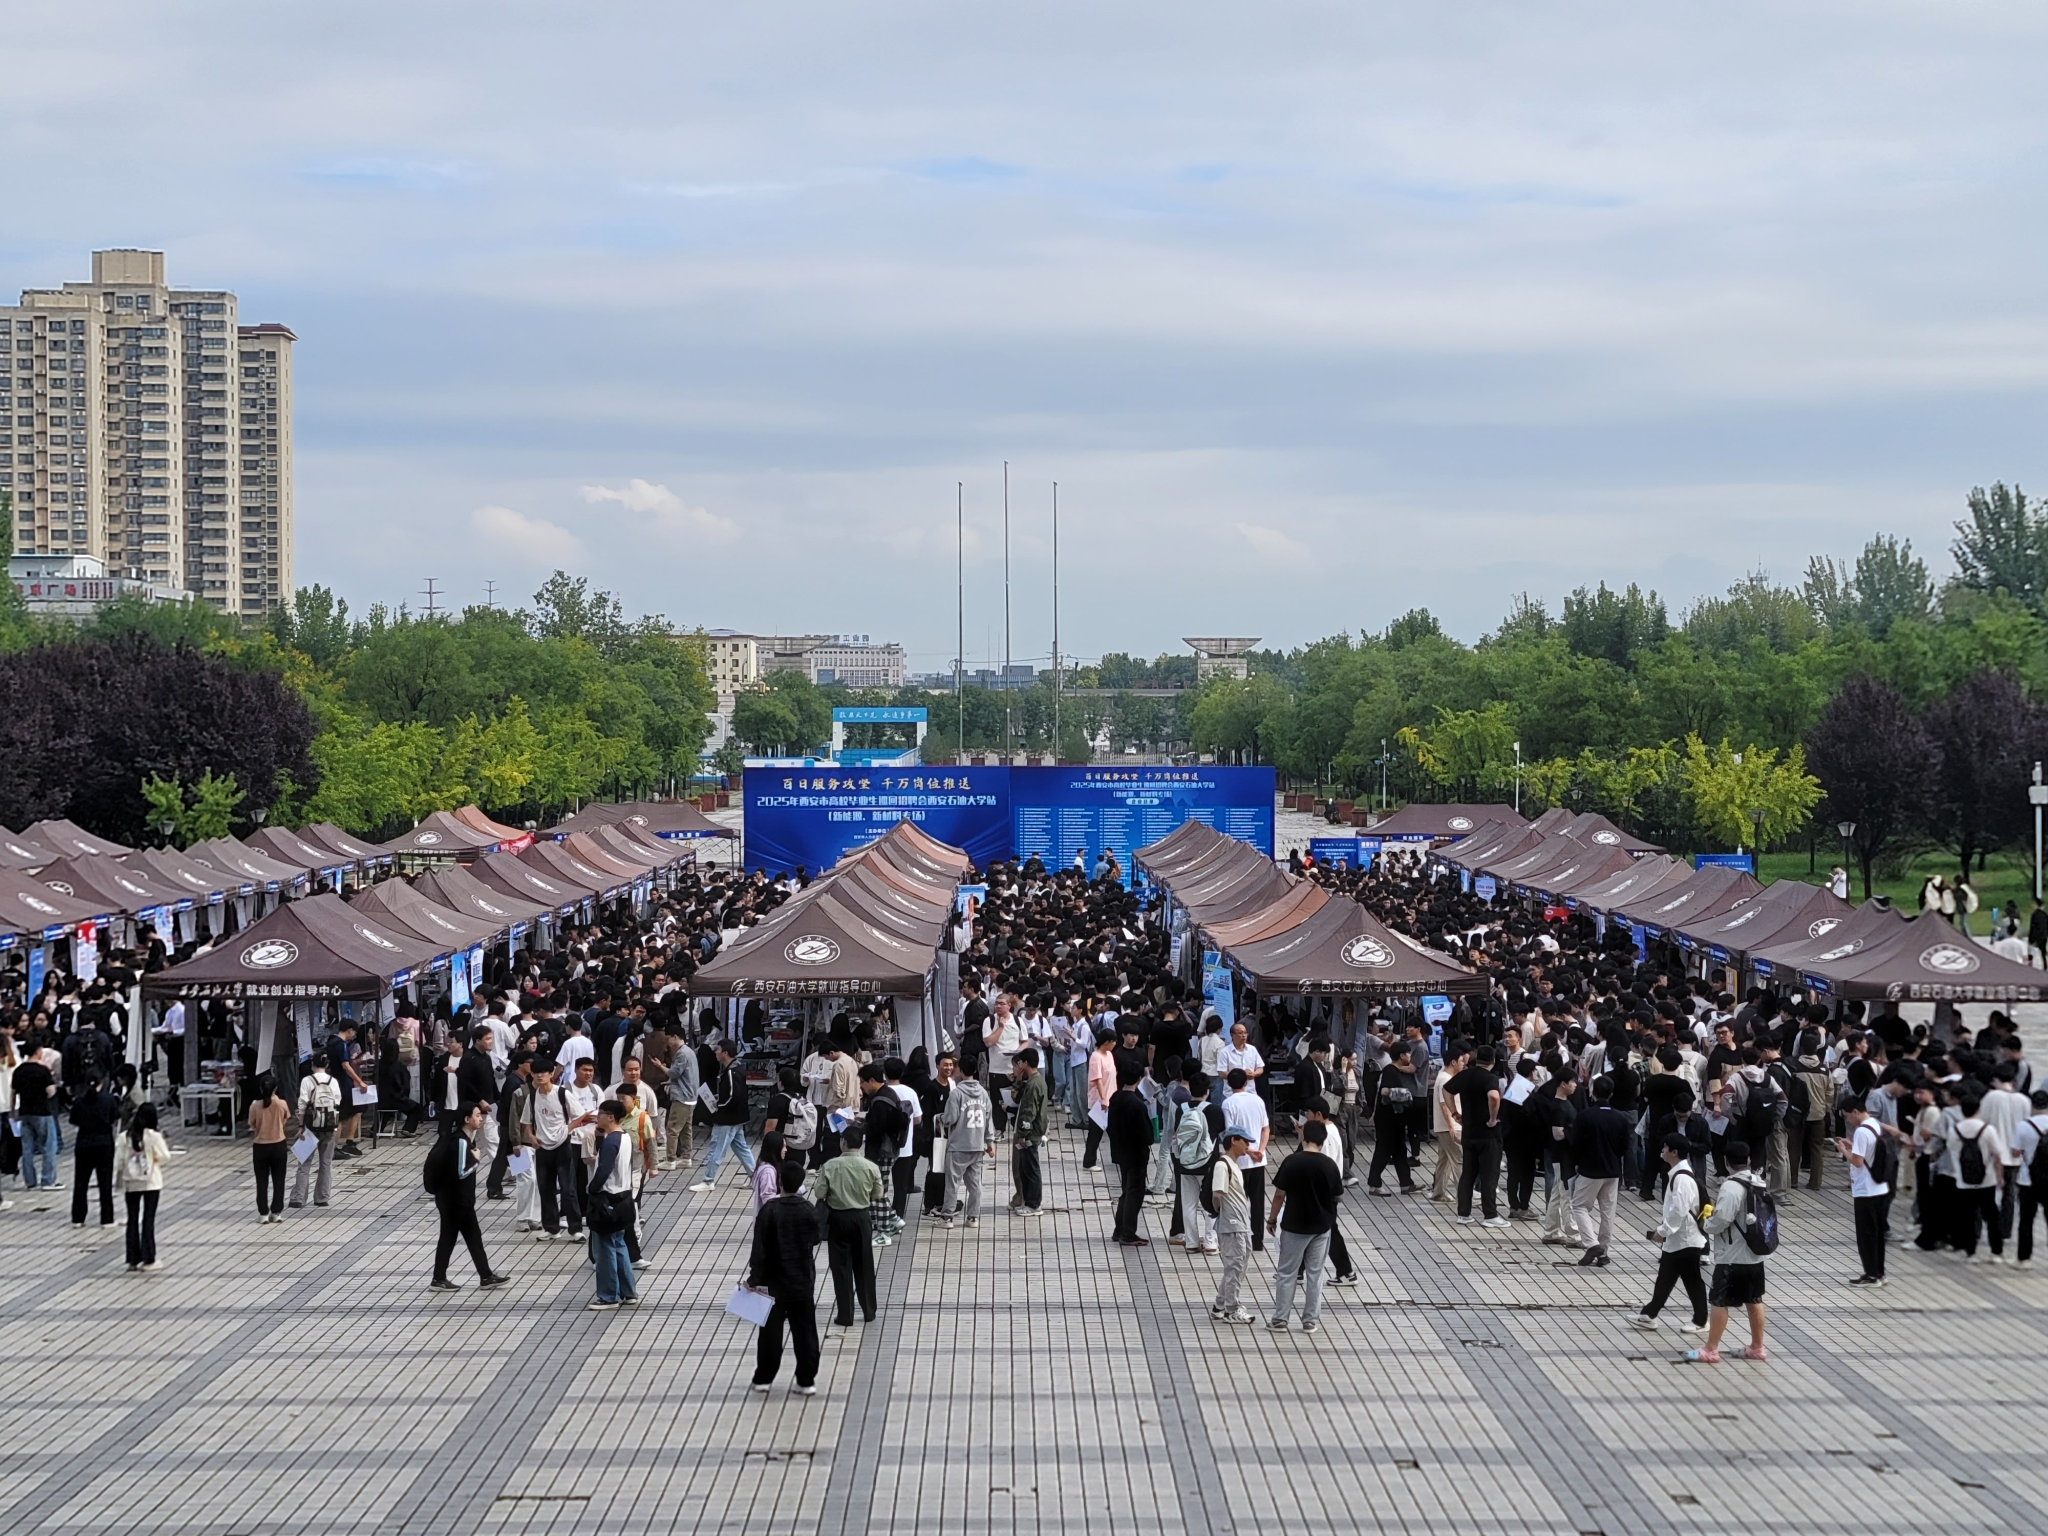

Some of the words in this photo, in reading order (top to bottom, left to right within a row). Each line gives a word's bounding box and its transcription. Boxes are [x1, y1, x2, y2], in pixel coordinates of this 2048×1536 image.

[1085, 773, 1138, 781] 百日服务攻坚
[1145, 772, 1199, 781] 千万岗位推送
[782, 778, 872, 791] 百日服务攻坚
[881, 776, 972, 790] 千万岗位推送
[757, 796, 997, 807] 2025年西安市高校毕业生巡回招聘会西安石油大学站
[246, 984, 342, 996] 就业创业指导中心
[754, 980, 881, 994] 西安石油大学就业指导中心
[1320, 979, 1447, 992] 西安石油大学就业指导中心
[966, 1109, 984, 1129] 23
